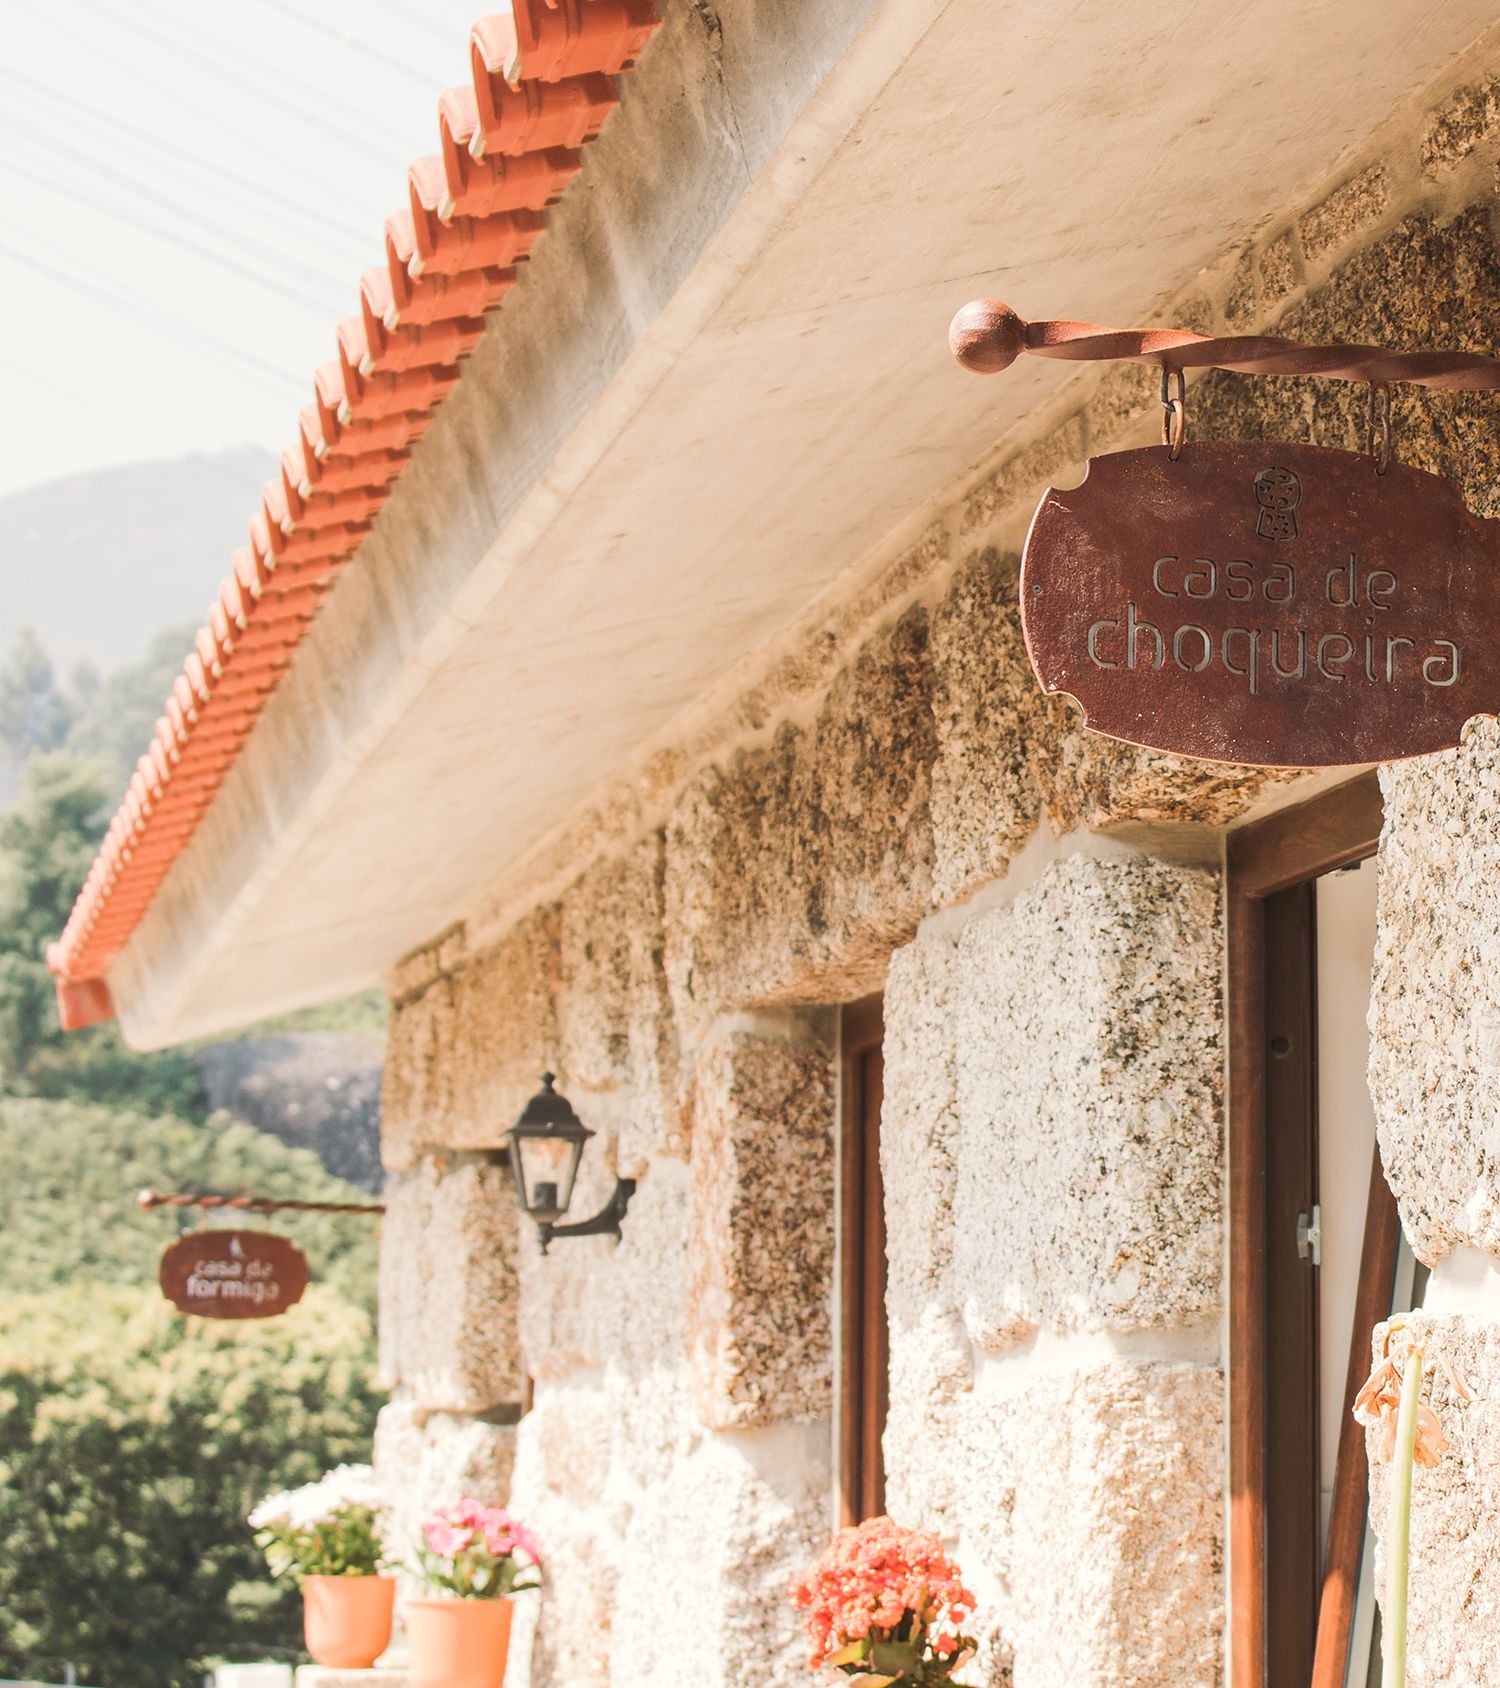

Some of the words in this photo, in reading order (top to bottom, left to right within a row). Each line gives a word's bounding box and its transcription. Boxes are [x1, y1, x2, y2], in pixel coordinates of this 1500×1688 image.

[1153, 556, 1297, 603] casa
[1325, 552, 1399, 611] de
[1087, 602, 1463, 695] choqueira
[186, 1273, 280, 1304] formiga
[194, 1260, 242, 1278] casa
